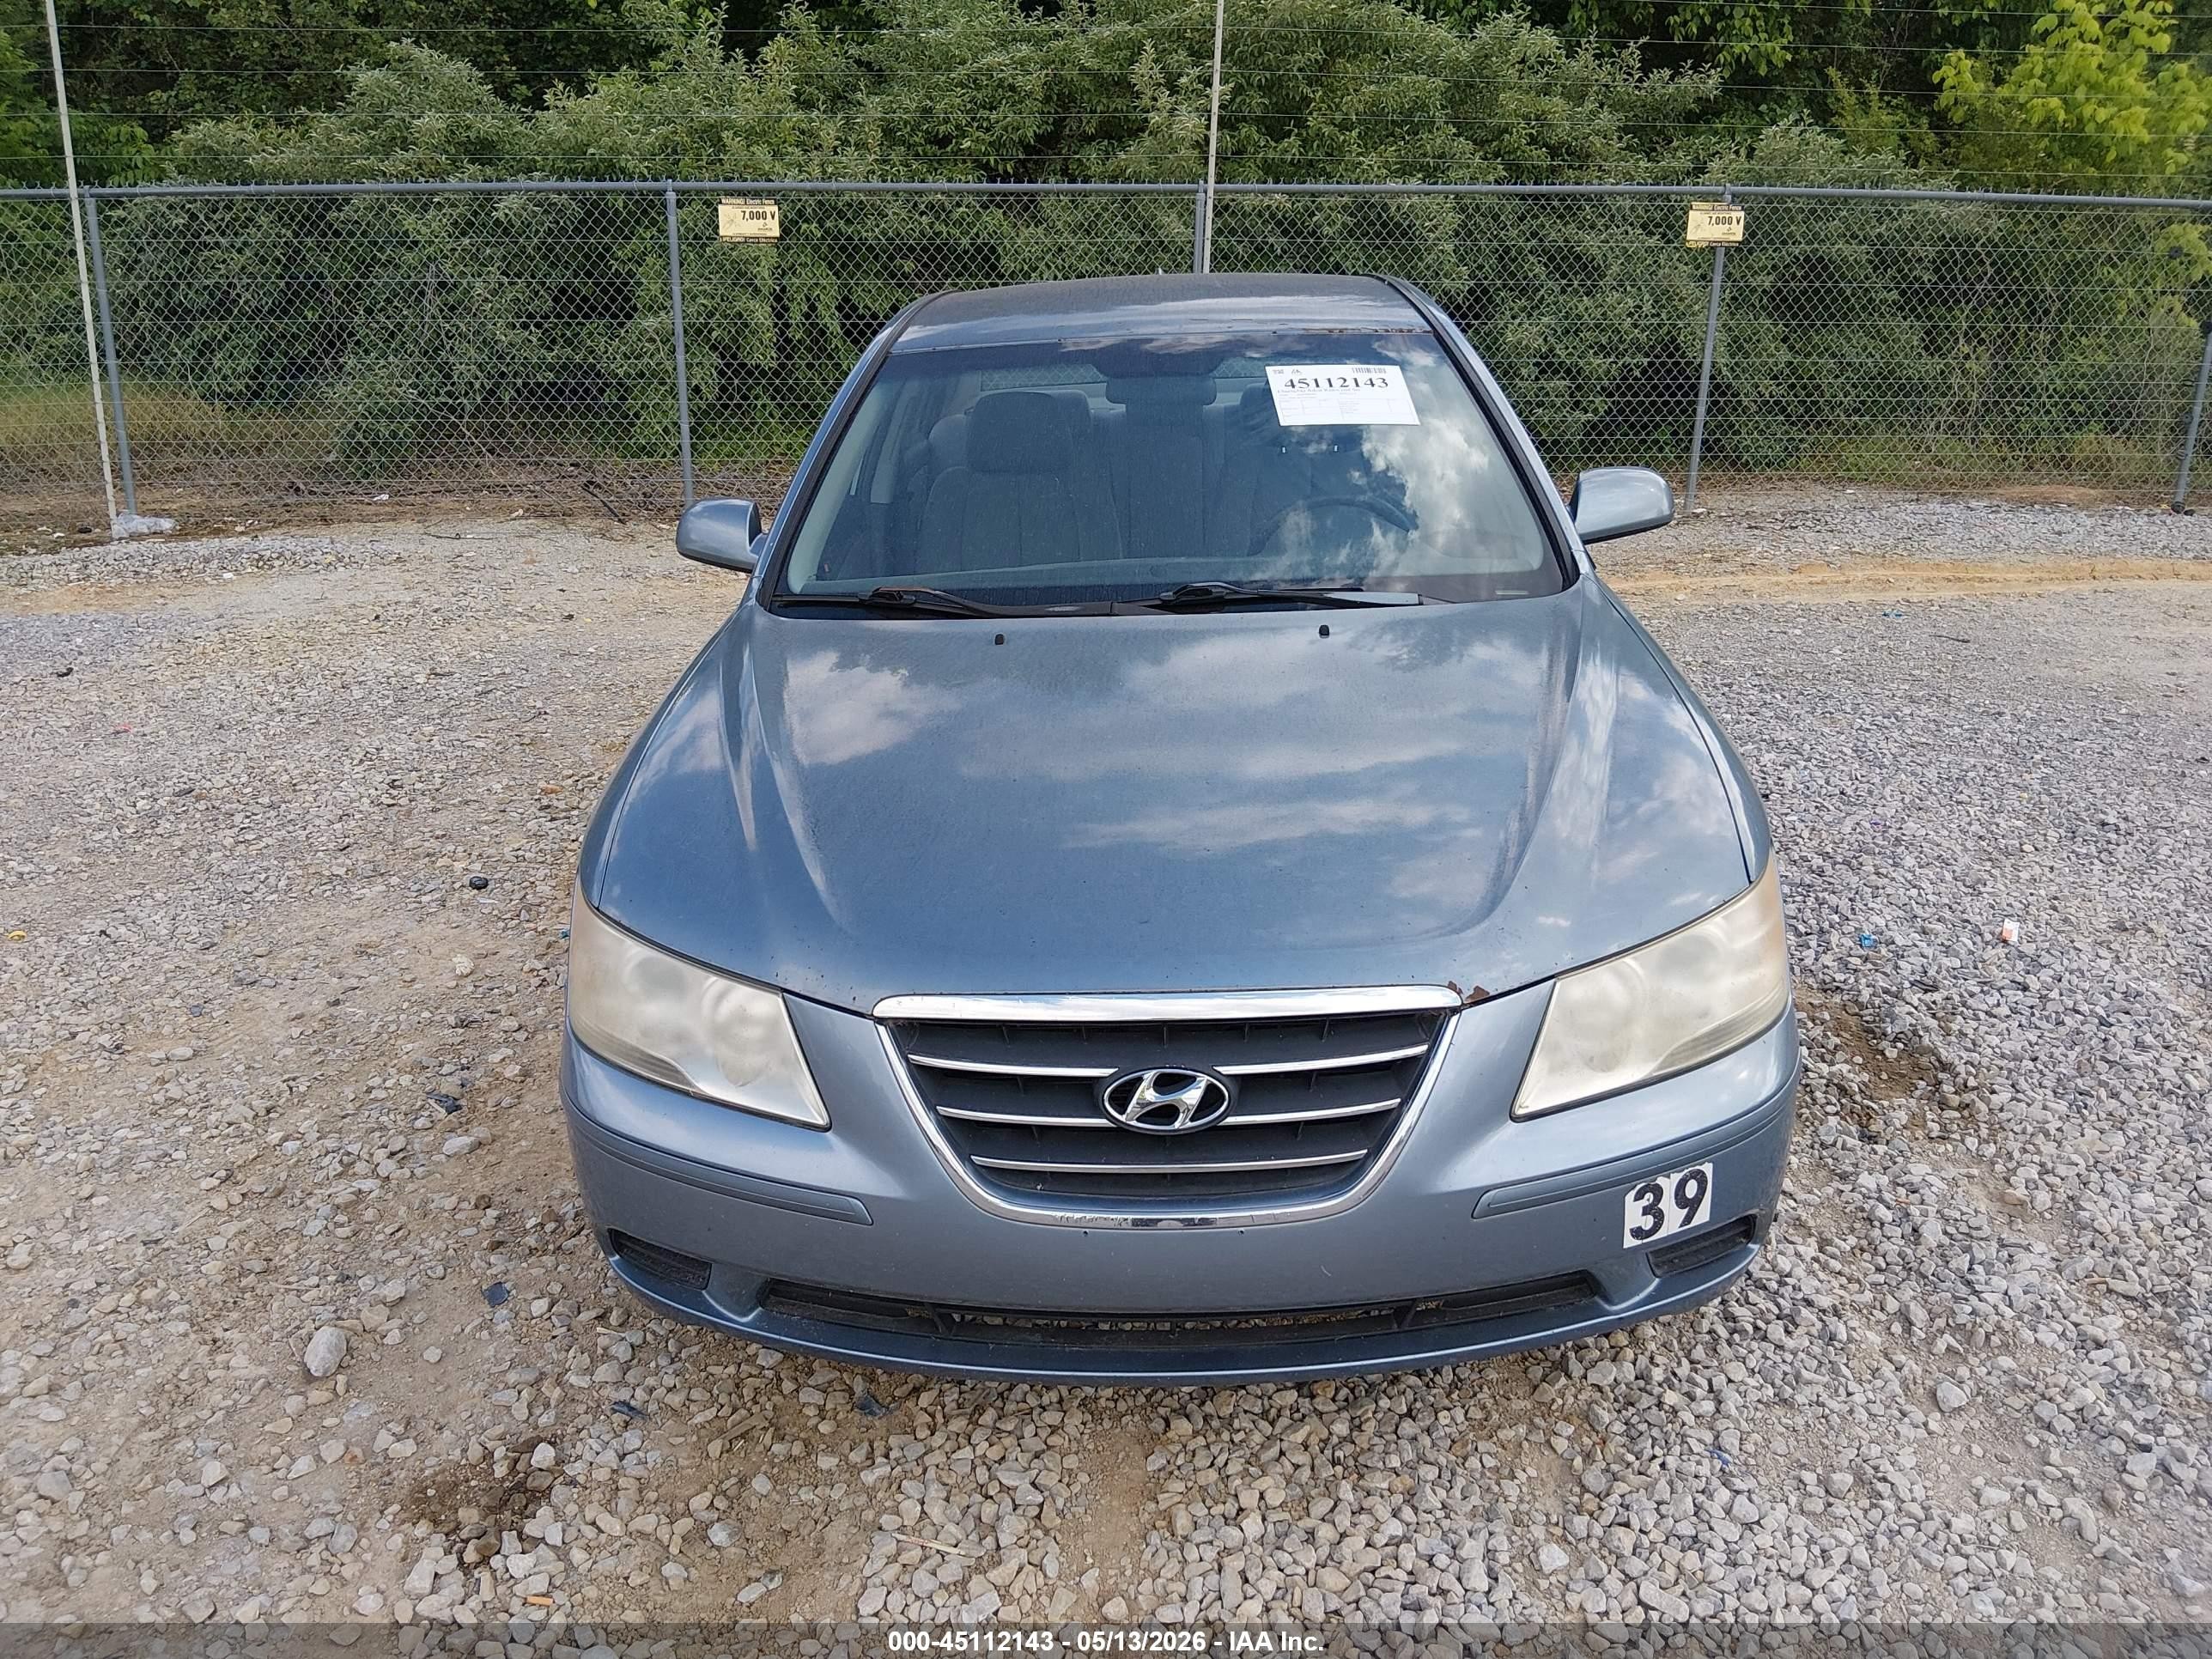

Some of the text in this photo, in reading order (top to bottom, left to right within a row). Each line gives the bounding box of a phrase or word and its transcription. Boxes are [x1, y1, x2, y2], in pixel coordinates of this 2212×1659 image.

[741, 210, 776, 222] 7,000 V
[1708, 216, 1741, 227] 7,000 V
[1284, 377, 1389, 389] 45112143
[1629, 1168, 1708, 1241] 39
